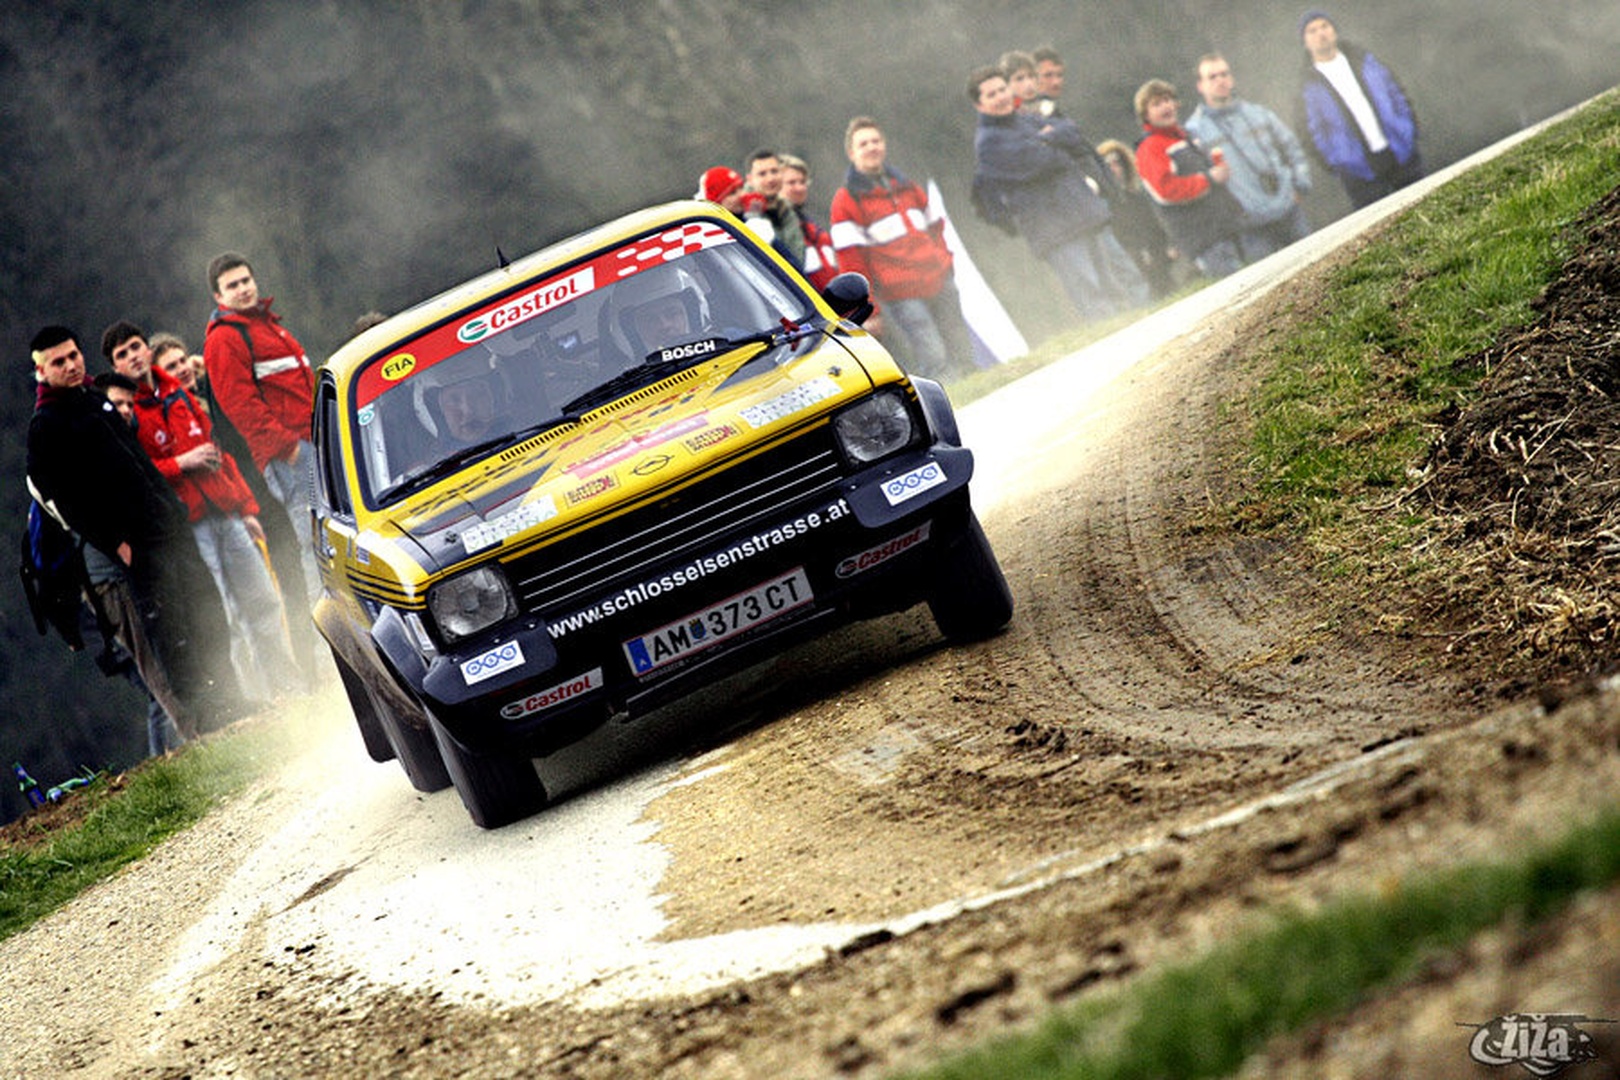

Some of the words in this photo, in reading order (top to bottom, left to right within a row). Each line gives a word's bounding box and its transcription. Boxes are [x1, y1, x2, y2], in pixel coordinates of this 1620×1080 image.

[491, 278, 578, 329] Castrol
[384, 358, 413, 377] FIA
[661, 340, 716, 362] BOSCH
[858, 528, 922, 569] Castrol
[653, 625, 692, 662] AM
[708, 596, 762, 636] 373
[765, 576, 800, 610] CT
[525, 675, 592, 711] Castrol
